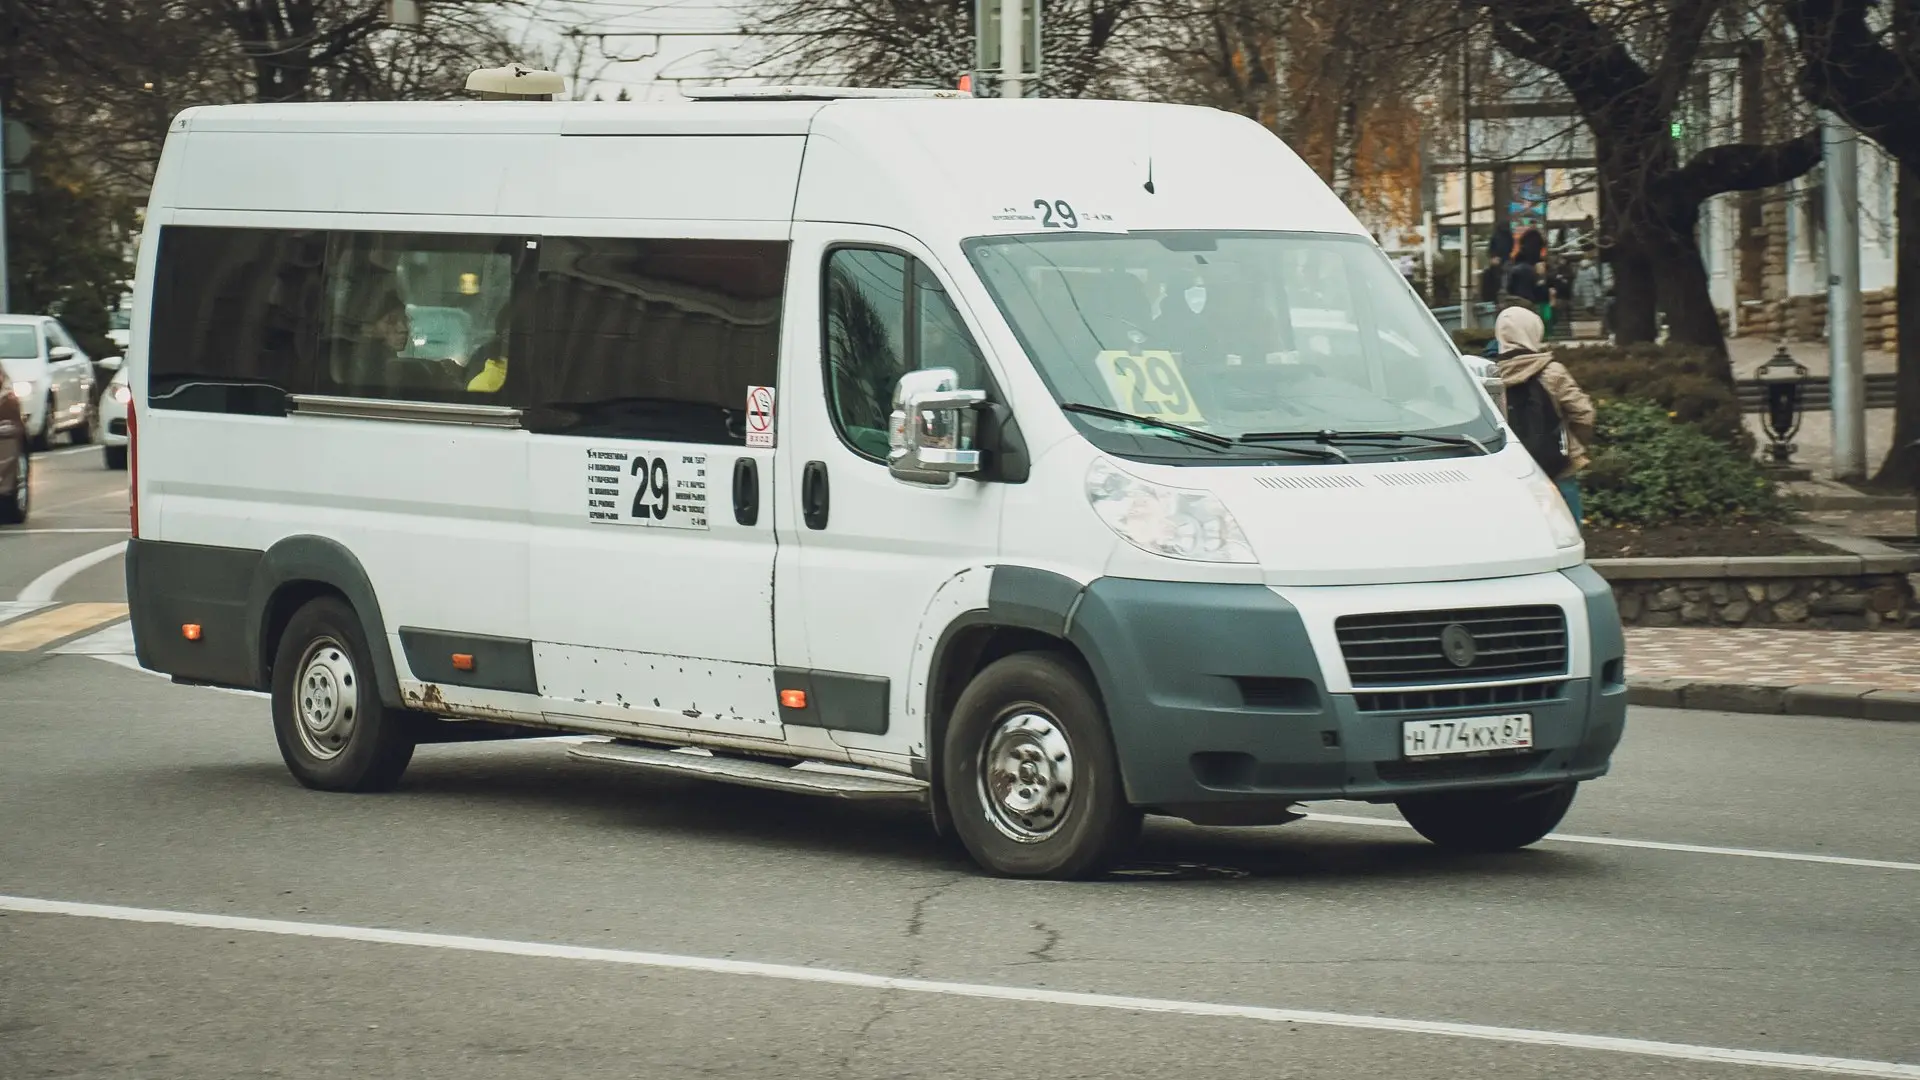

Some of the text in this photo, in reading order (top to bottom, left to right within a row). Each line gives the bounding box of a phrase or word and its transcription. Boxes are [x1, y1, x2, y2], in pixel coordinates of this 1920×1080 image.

[1034, 199, 1078, 228] 29
[1113, 357, 1190, 415] 29
[631, 456, 669, 520] 29
